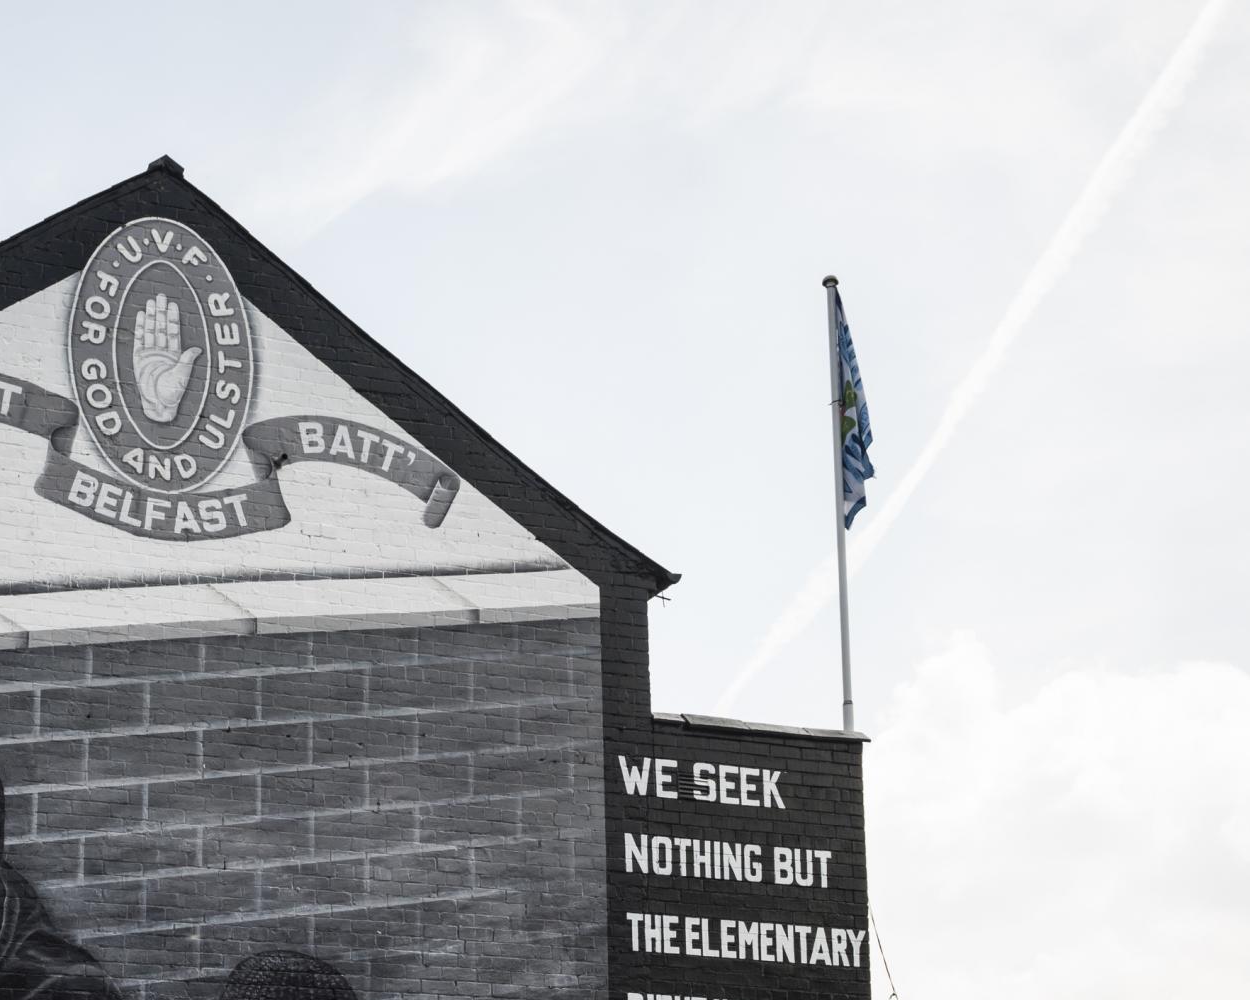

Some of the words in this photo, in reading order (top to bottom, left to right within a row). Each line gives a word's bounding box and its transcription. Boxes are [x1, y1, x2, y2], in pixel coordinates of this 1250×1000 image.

[80, 270, 120, 345] FOR
[81, 357, 122, 436] GOD
[198, 291, 243, 450] ULSTER
[122, 447, 197, 481] AND
[68, 469, 249, 534] BELFAST
[618, 755, 679, 800] WE
[692, 763, 786, 810] SEEK
[625, 832, 762, 884] NOTHING
[773, 846, 832, 888] BUT
[626, 912, 681, 955] THE
[685, 916, 866, 968] ELEMENTARY
